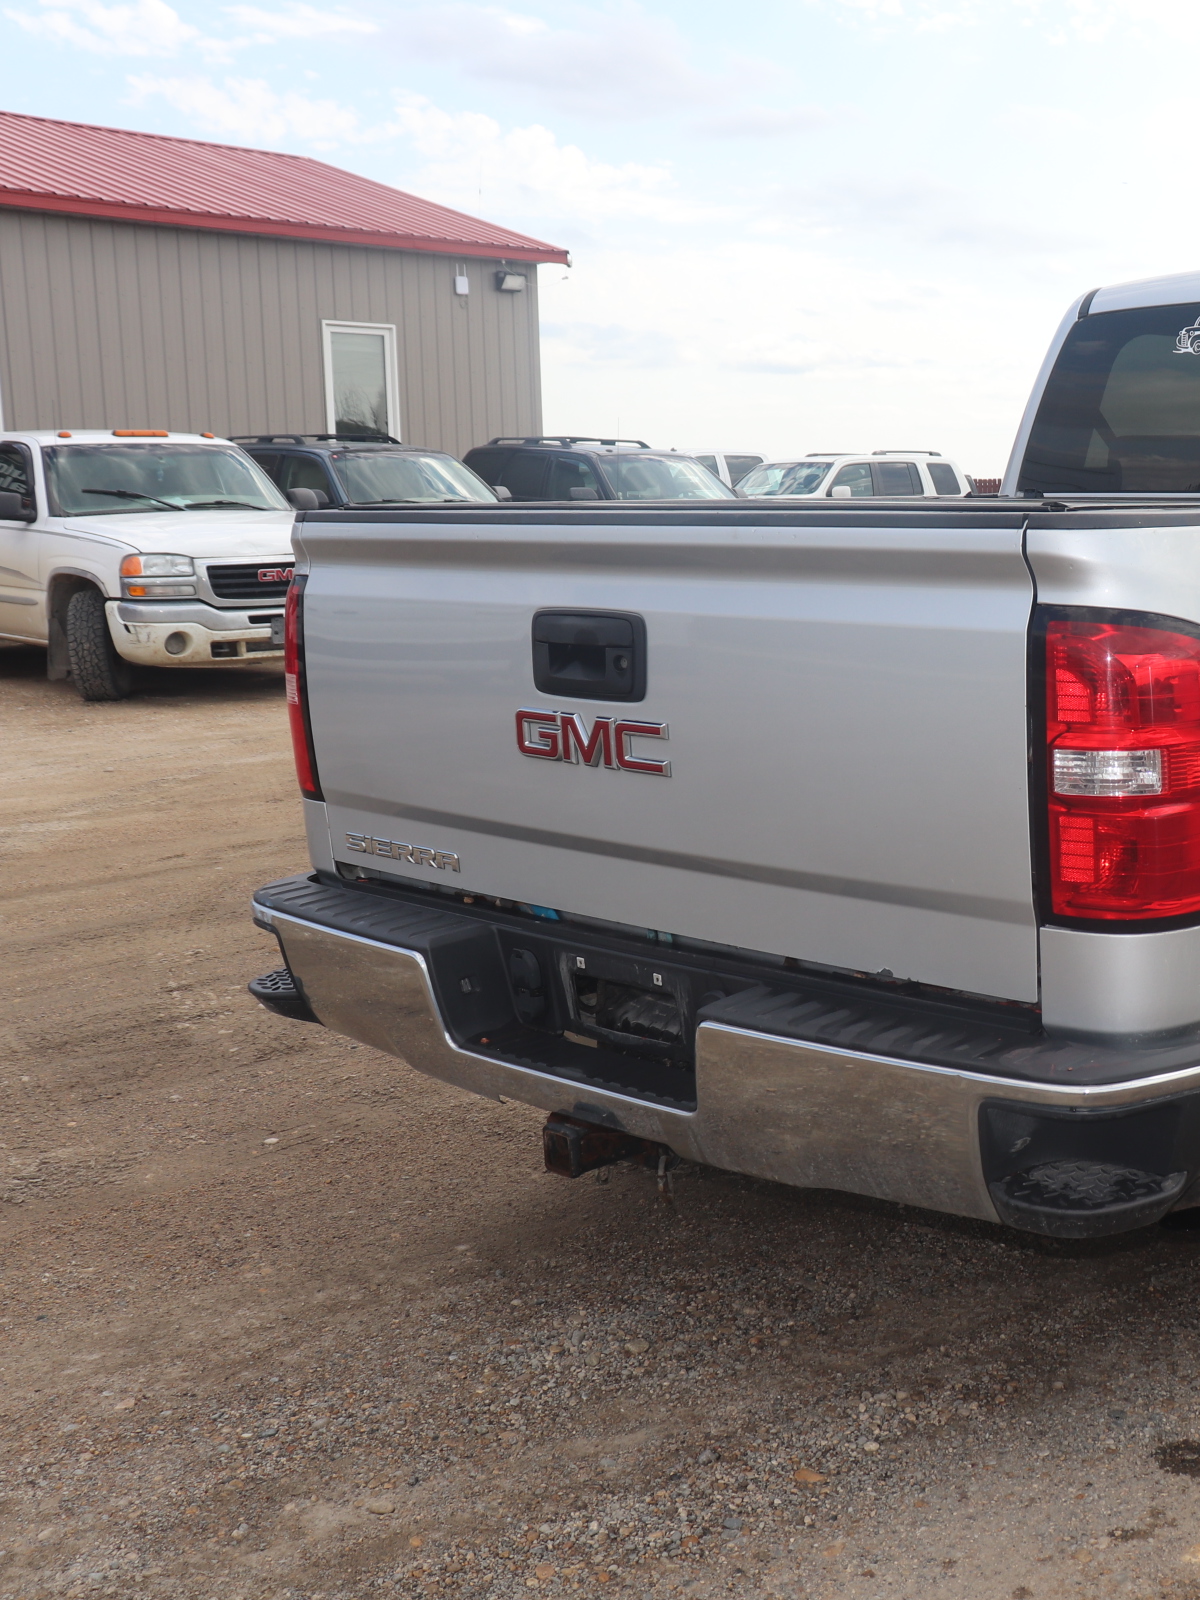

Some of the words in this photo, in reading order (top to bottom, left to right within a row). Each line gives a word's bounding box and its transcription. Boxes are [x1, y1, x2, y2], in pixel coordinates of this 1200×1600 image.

[257, 567, 295, 582] GM
[515, 706, 672, 778] GMC
[345, 831, 461, 874] SIERRA
